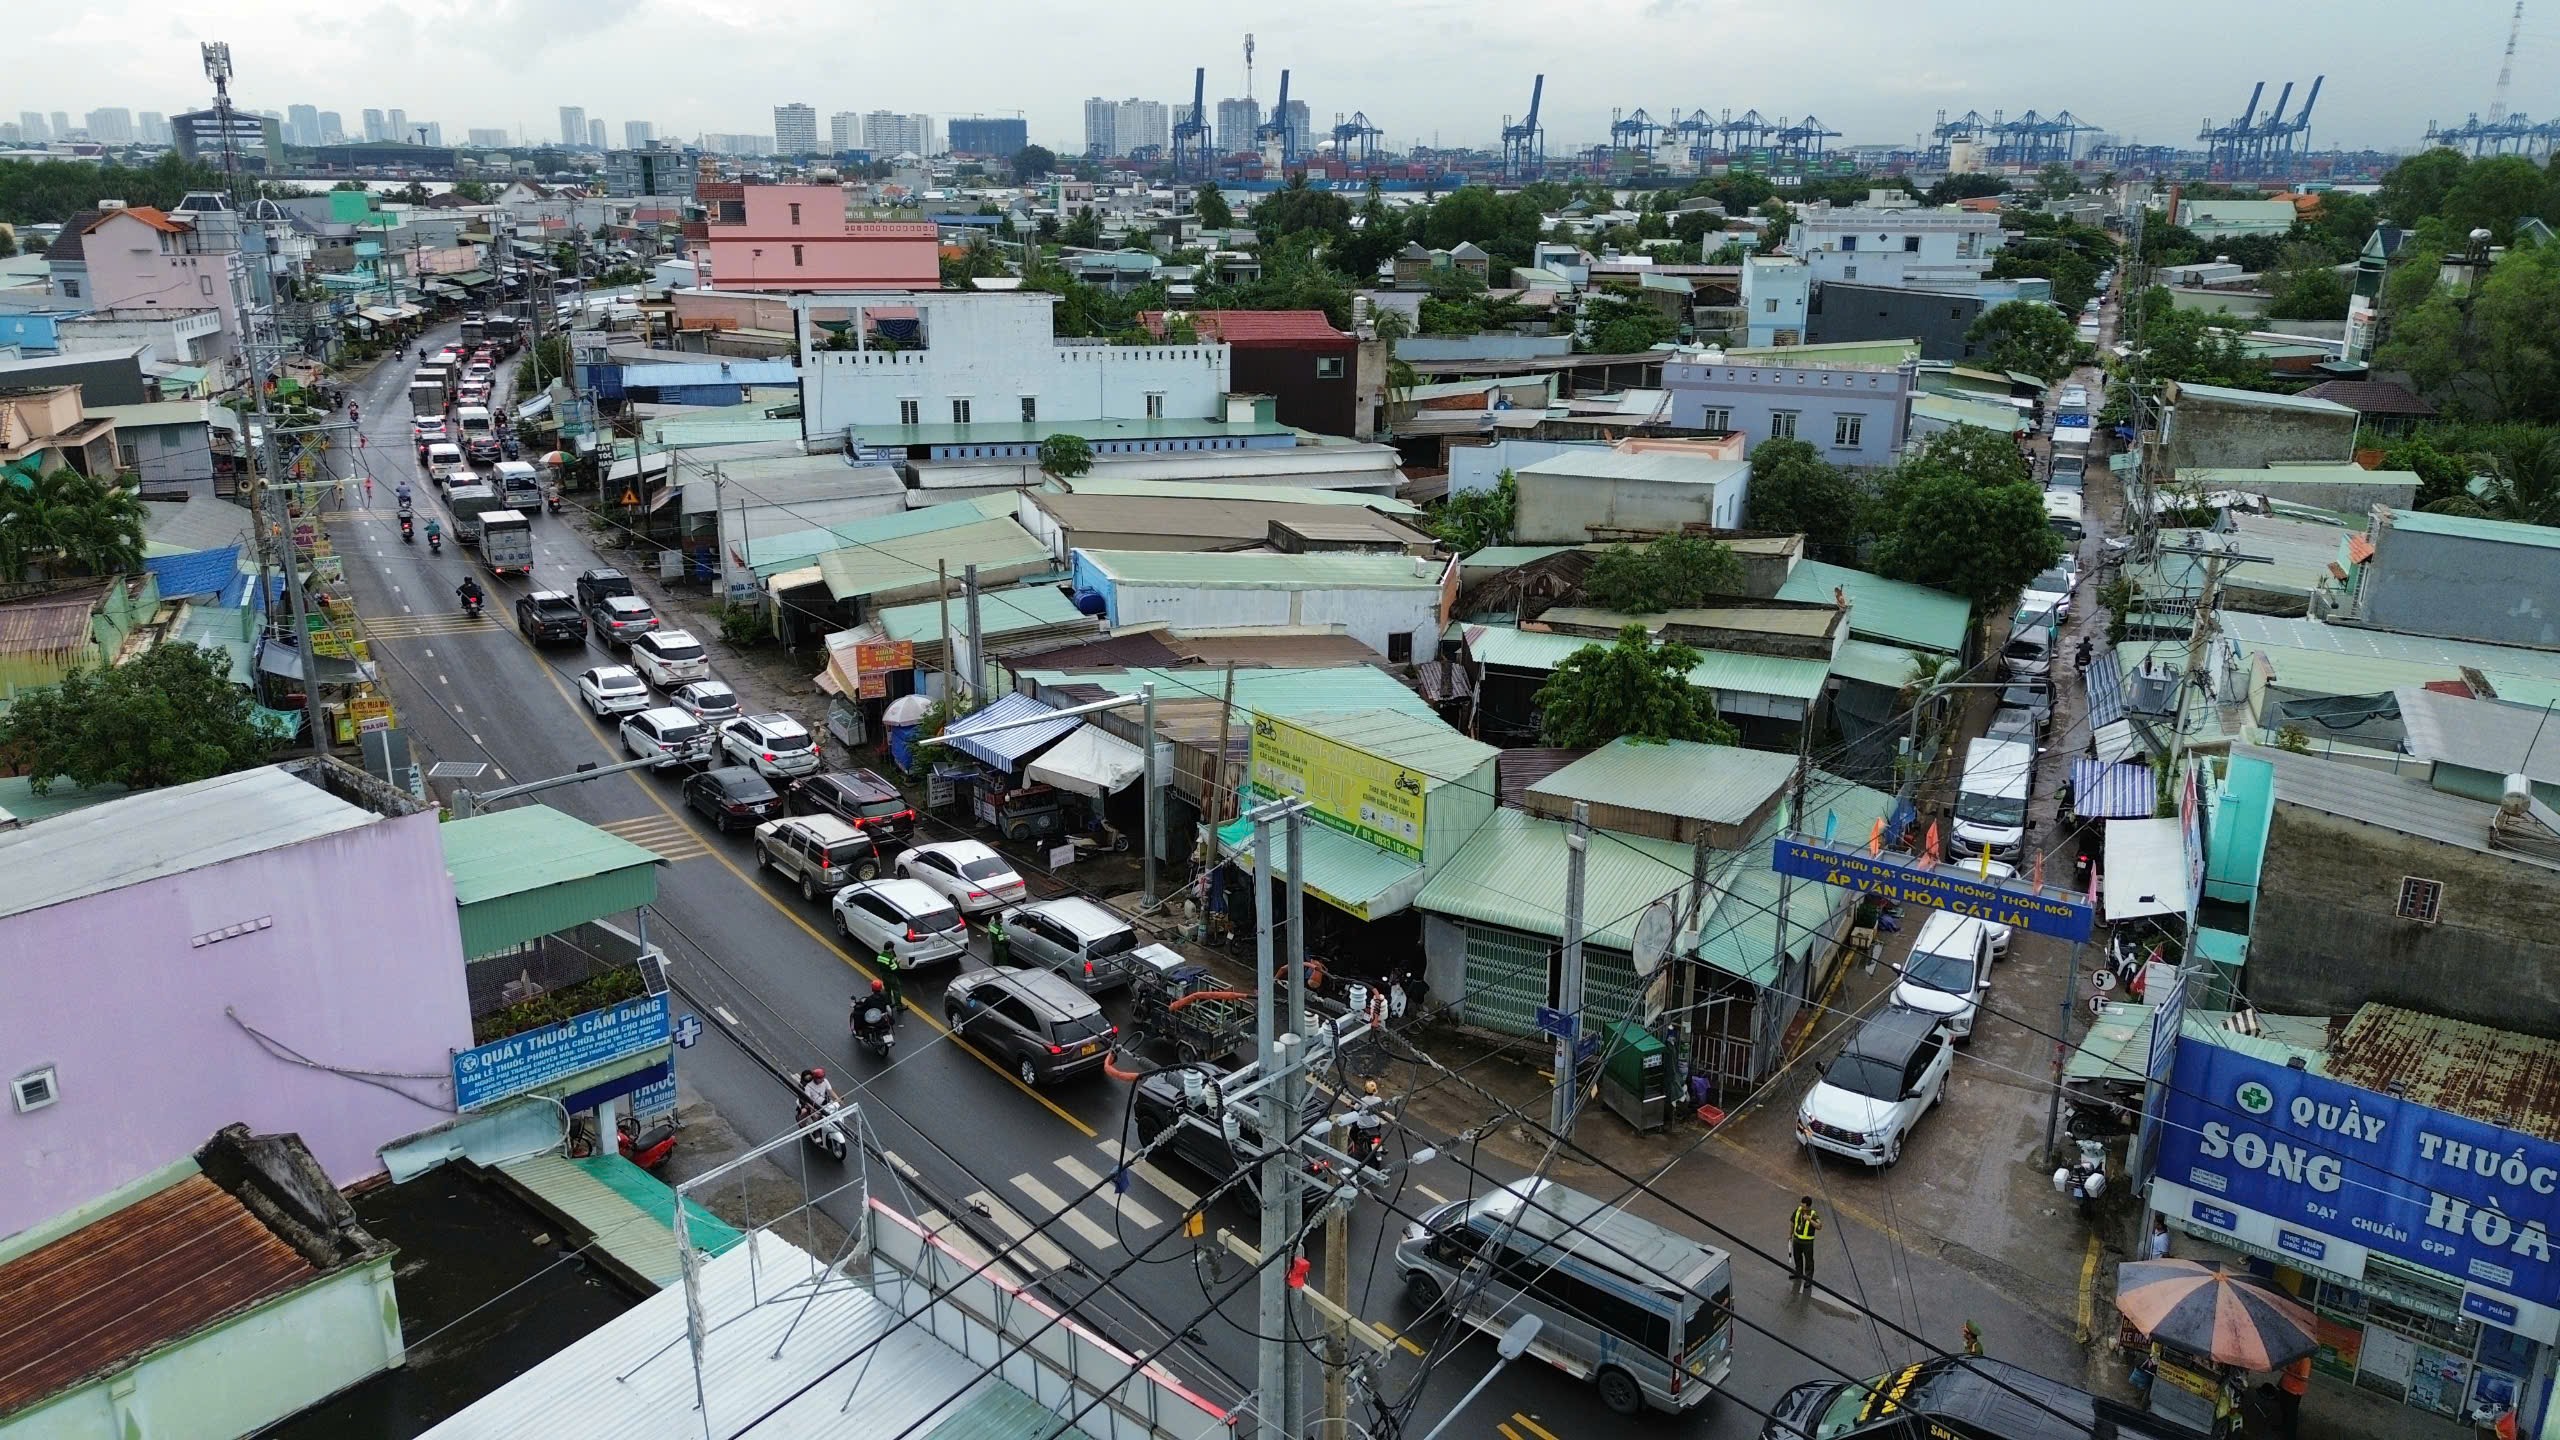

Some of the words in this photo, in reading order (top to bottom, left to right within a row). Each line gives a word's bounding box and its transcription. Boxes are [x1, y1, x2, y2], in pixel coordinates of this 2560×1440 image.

[1765, 176, 1801, 185] REEN
[1826, 869, 1853, 887] ẤP
[1903, 888, 1946, 909] HÓA
[1999, 907, 2030, 929] LÁI
[2001, 894, 2041, 910] THÔN
[2044, 902, 2073, 918] MỚI
[2290, 1095, 2386, 1144] QUẦY
[2419, 1131, 2559, 1194] THUỐC
[2200, 1121, 2342, 1193] SONG
[2425, 1190, 2551, 1263] HÒA
[2306, 1201, 2338, 1220] ĐẠT
[2351, 1216, 2408, 1243] CHUẨN
[2421, 1239, 2456, 1257] GPP
[2121, 1331, 2132, 1342] XE
